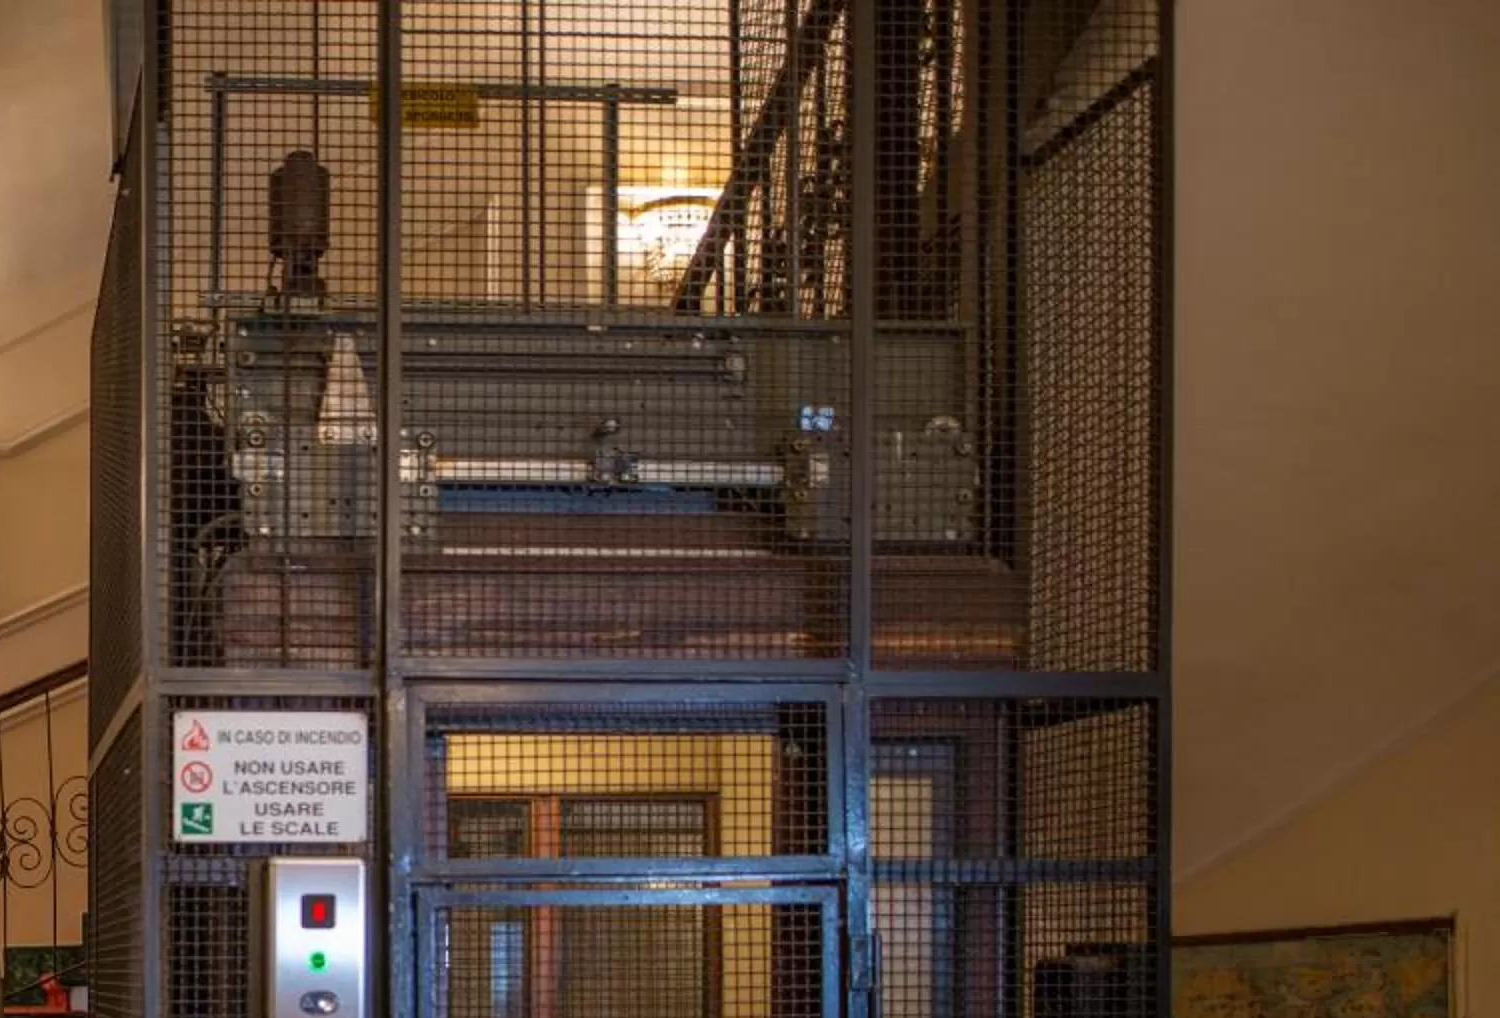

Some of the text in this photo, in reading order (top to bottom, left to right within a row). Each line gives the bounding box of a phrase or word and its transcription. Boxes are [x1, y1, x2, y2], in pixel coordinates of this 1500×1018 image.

[217, 729, 362, 745] IN CASO DI INCENDIO
[233, 760, 345, 776] NON USARE
[222, 780, 357, 796] L'ASCENSORE
[254, 801, 325, 817] USARE
[239, 820, 340, 836] LE SCALE
